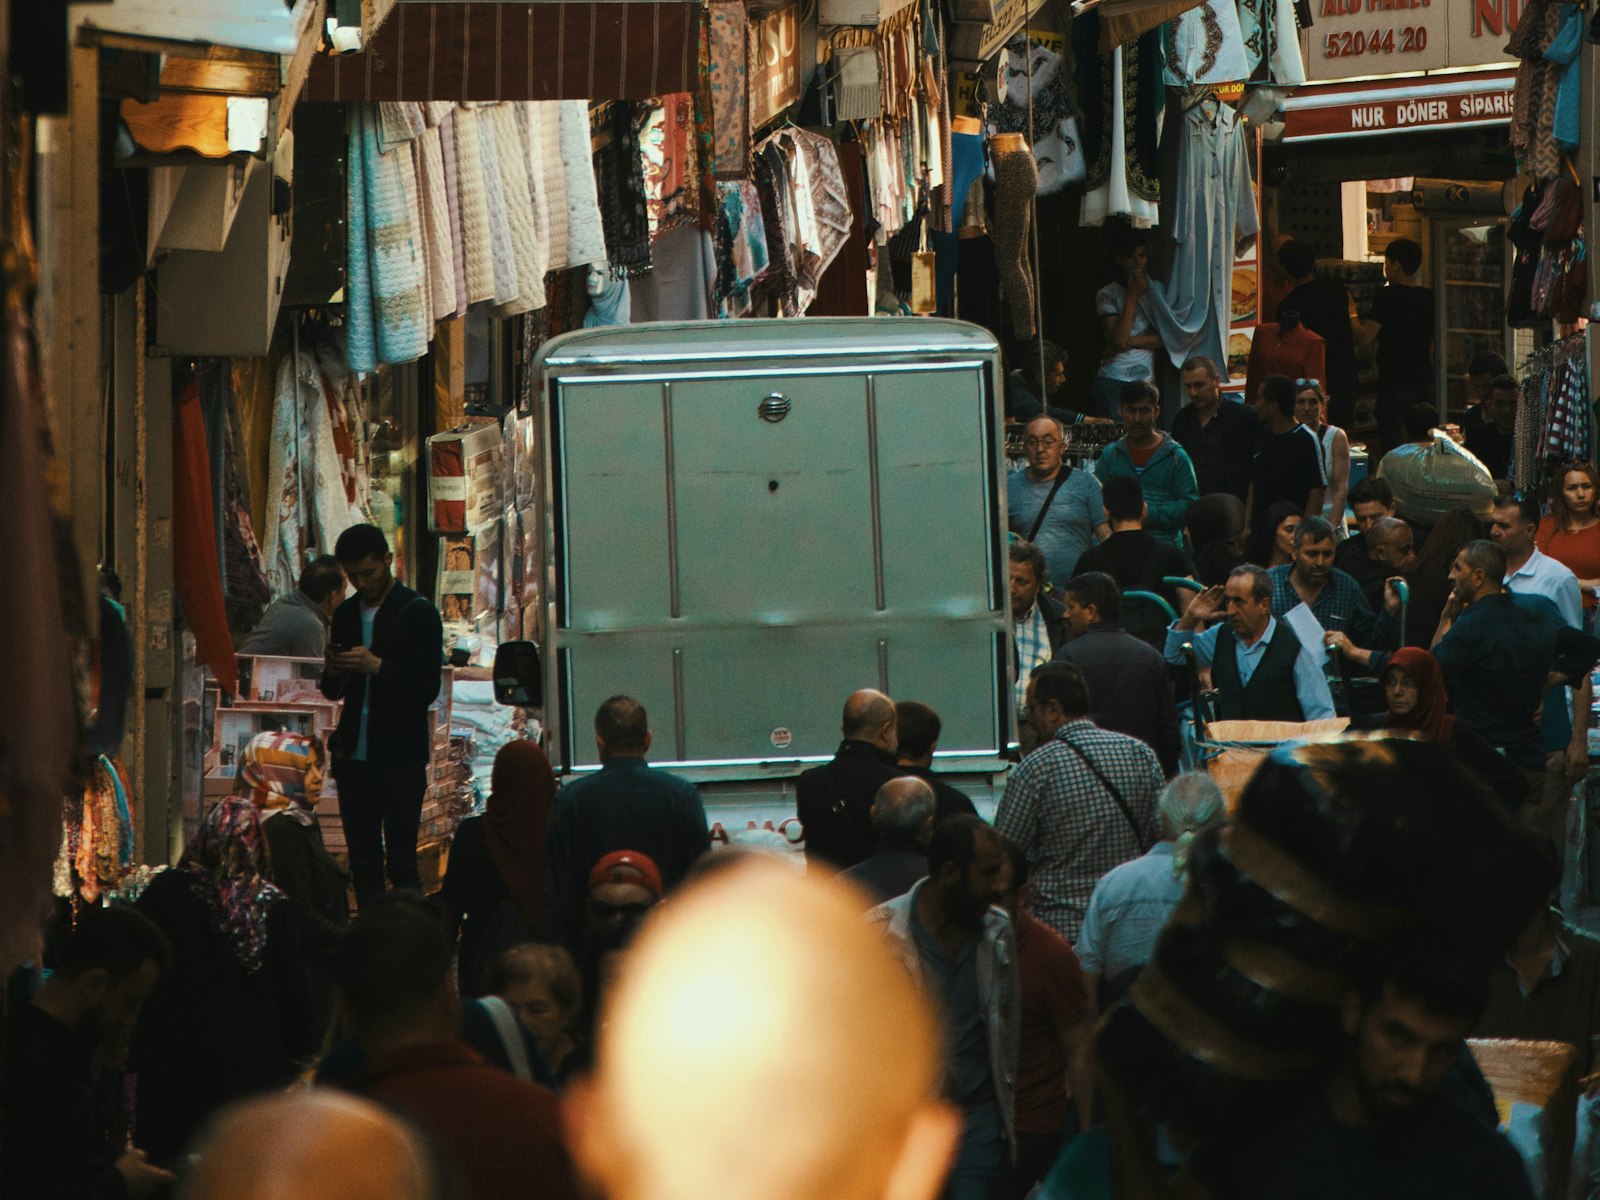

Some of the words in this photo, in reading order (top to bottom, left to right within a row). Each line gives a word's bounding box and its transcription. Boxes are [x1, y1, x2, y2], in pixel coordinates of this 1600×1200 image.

[1400, 26, 1428, 52] 20
[1351, 108, 1385, 129] NUR
[1397, 100, 1449, 125] DÖNER
